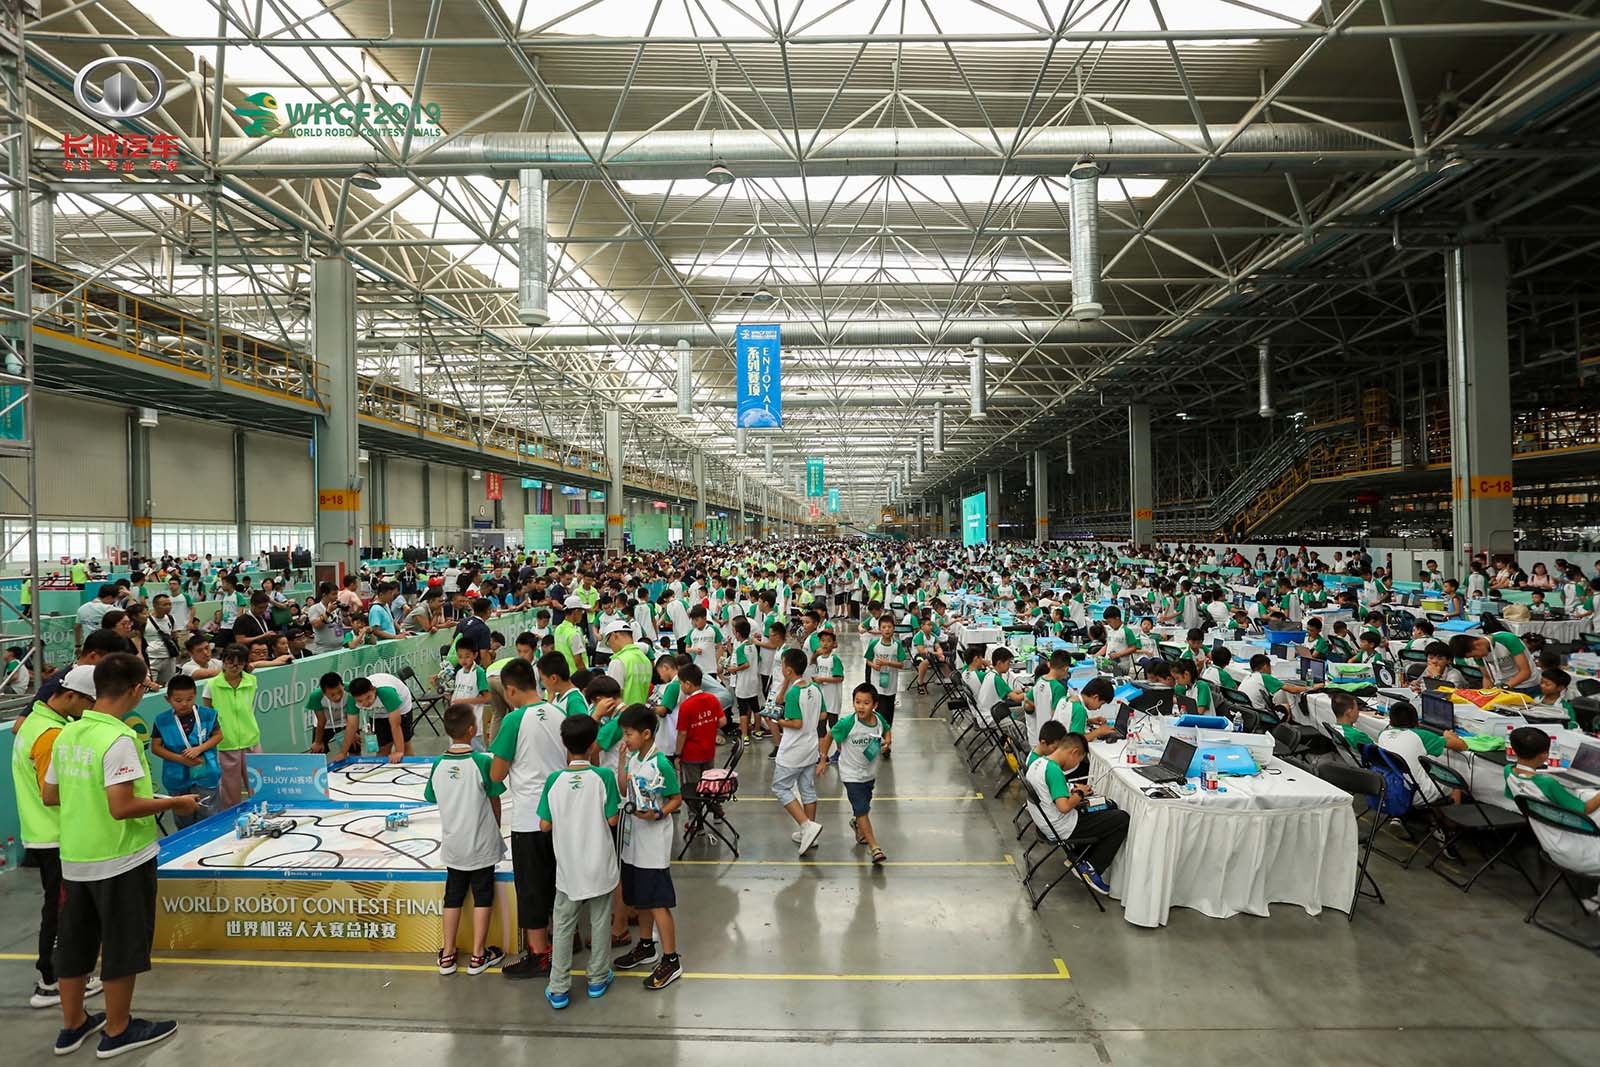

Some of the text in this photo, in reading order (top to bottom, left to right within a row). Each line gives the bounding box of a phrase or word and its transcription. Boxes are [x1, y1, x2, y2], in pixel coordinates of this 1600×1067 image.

[762, 347, 771, 413] ENJOY AI
[1480, 481, 1511, 493] C-18
[43, 629, 74, 646] BOT
[263, 776, 288, 784] ENJOY
[162, 896, 230, 913] WORLD
[234, 896, 299, 914] ROBOT
[303, 897, 390, 915] CONTEST
[226, 920, 396, 938] 世界机器人大赛总决赛
